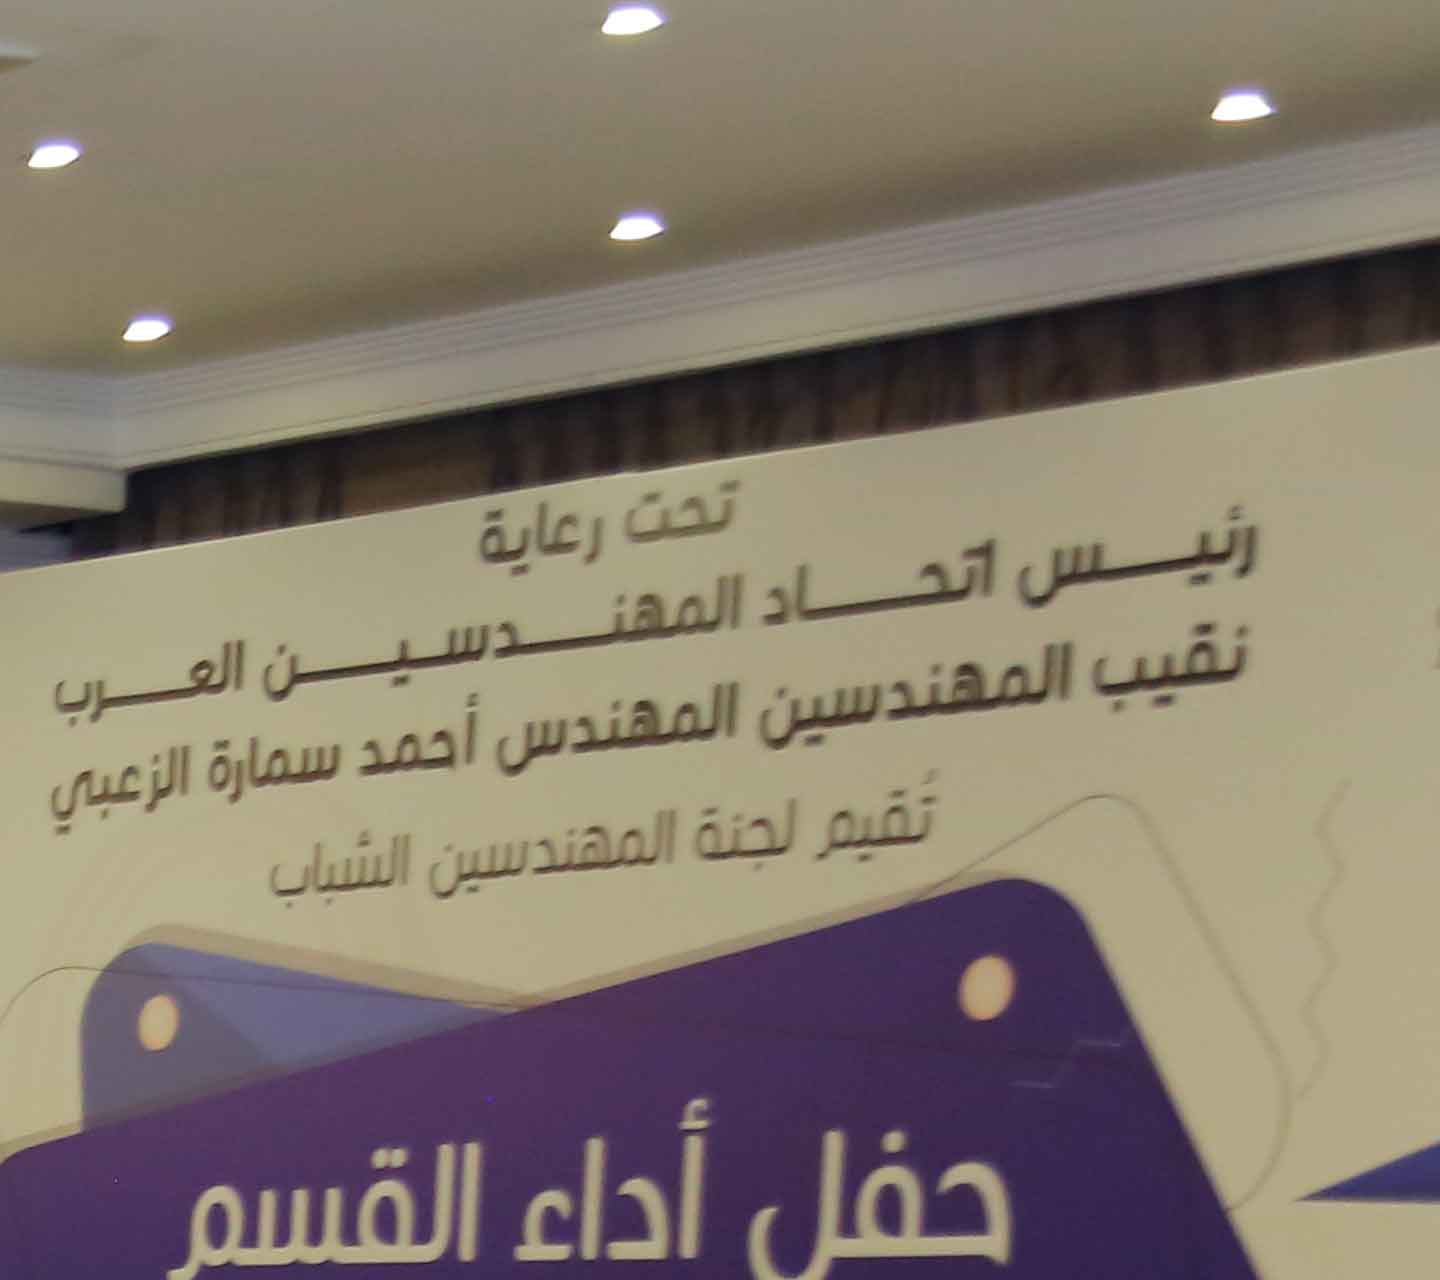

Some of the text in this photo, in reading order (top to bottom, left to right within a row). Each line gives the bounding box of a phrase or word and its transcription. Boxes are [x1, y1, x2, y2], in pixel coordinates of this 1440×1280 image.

[479, 480, 740, 576] تحت رعاية
[54, 505, 1261, 727] رئيس اتحاد المهندسين العرب
[50, 622, 1250, 835] نقيب المهندسين المهندس أحمد سمارة الزعبي
[270, 831, 412, 908] الشباب
[429, 808, 677, 901] المهندسين
[696, 798, 798, 871] لجنة
[513, 1096, 713, 1262] أداء
